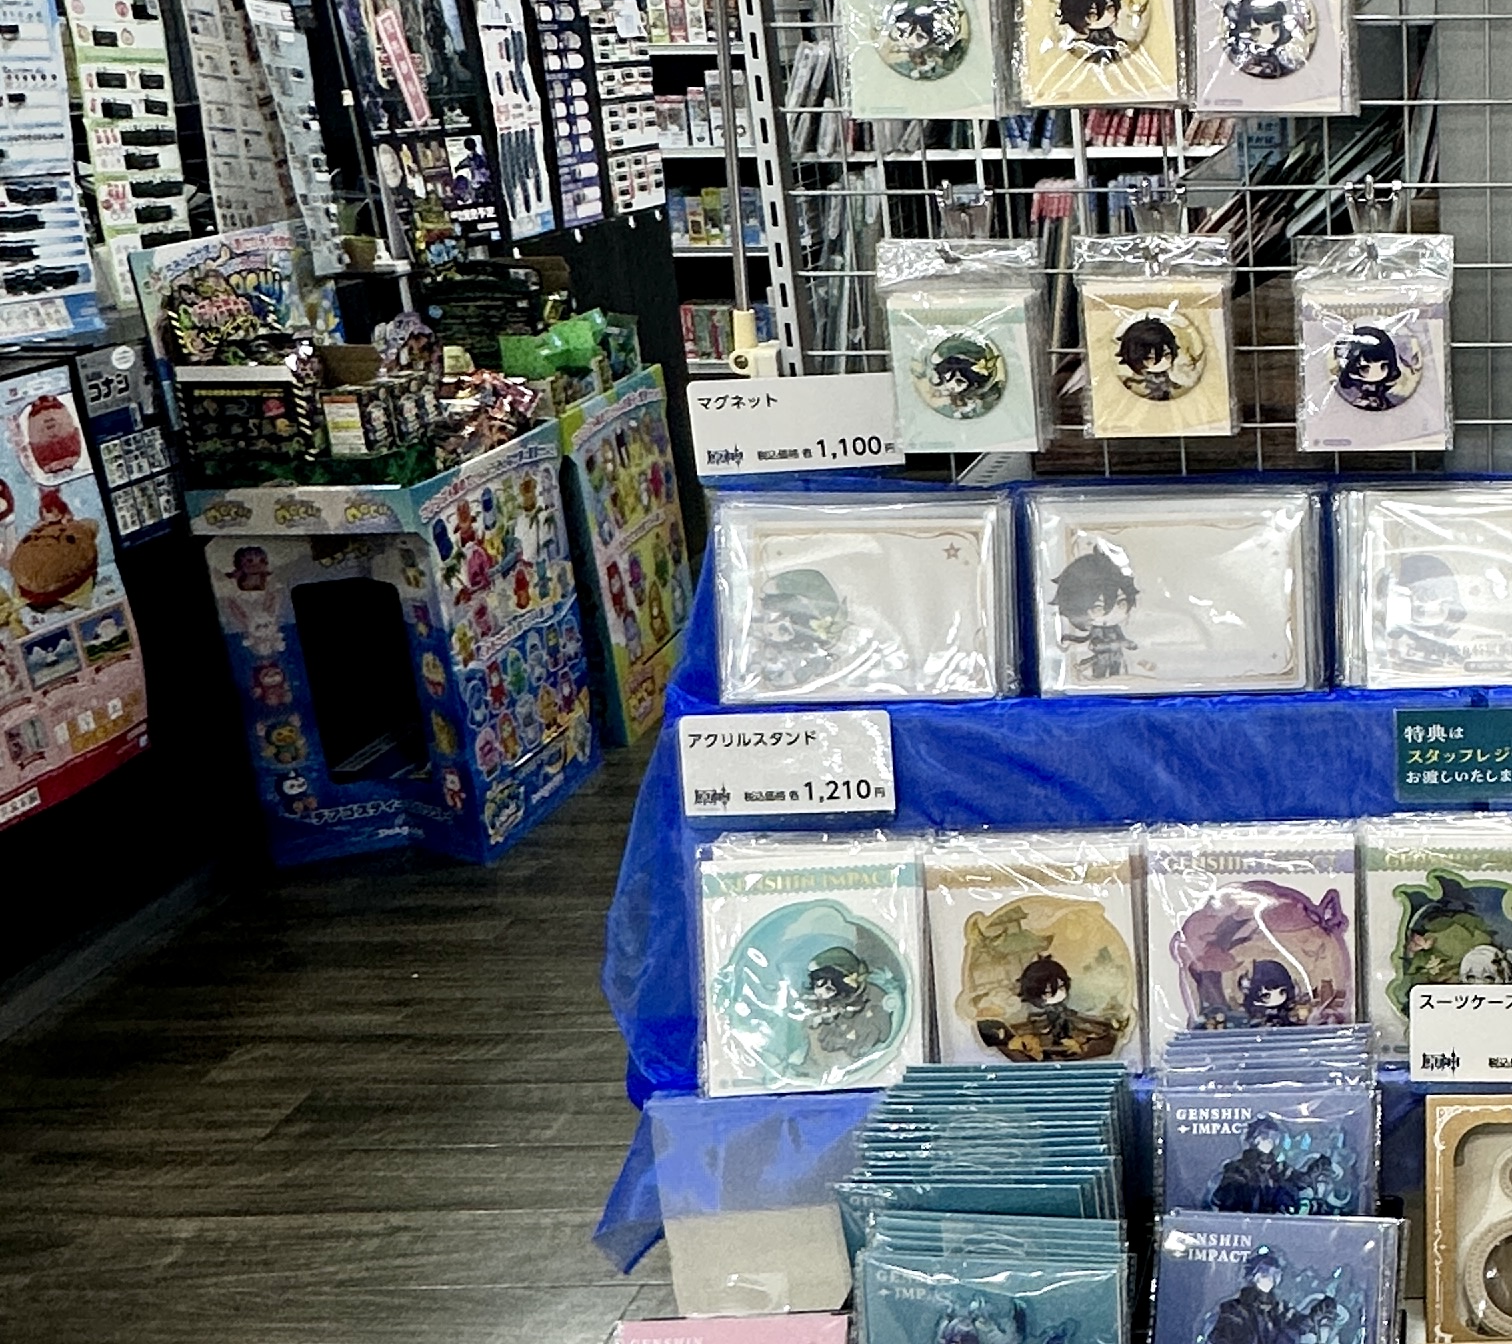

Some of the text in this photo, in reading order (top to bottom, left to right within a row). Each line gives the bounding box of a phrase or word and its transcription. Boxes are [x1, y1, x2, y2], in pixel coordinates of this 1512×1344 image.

[697, 392, 779, 411] マグネット
[687, 729, 818, 749] アクリルスタンド
[1403, 723, 1465, 745] 特典は
[1175, 1108, 1253, 1121] GENSHIN
[1187, 1248, 1252, 1264] IMPACT
